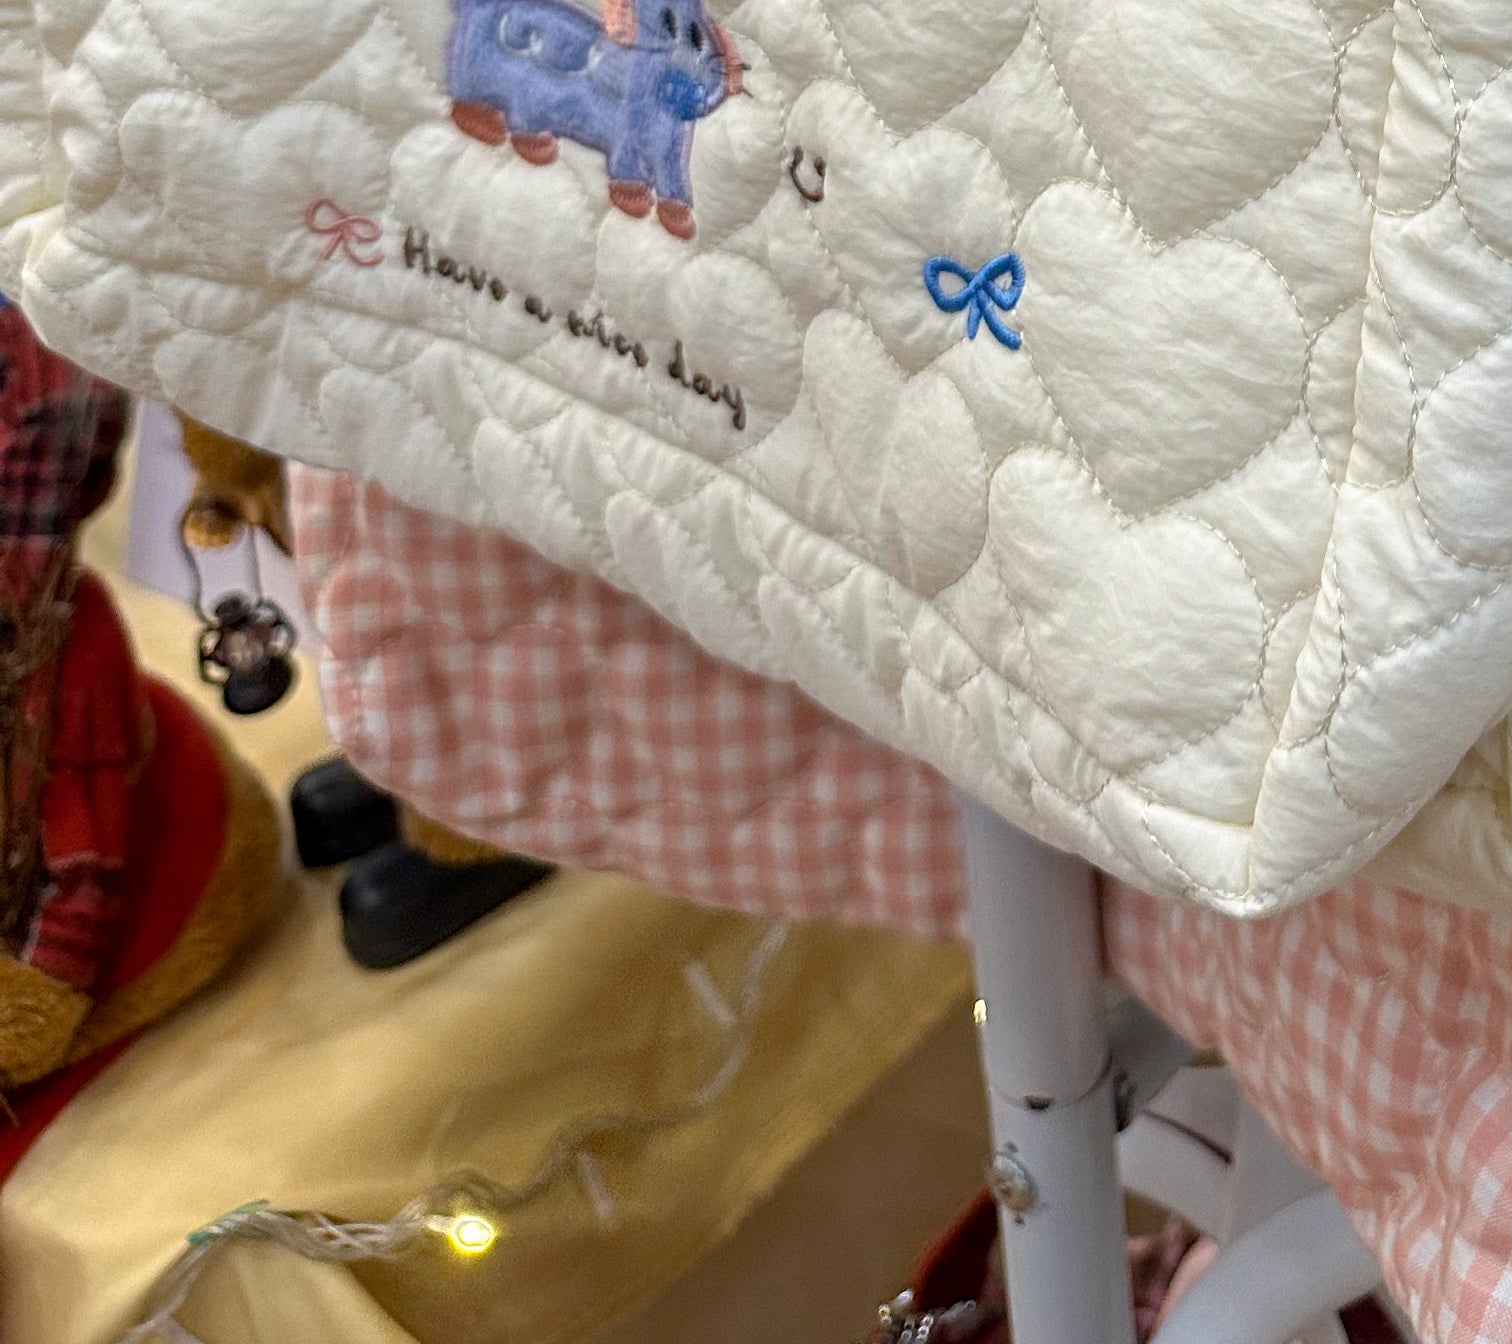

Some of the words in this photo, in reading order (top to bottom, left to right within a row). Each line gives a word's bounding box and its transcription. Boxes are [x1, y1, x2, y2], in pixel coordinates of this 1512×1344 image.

[404, 225, 507, 300] Have
[524, 292, 551, 323] a
[567, 309, 649, 368] nice
[668, 338, 746, 431] day
